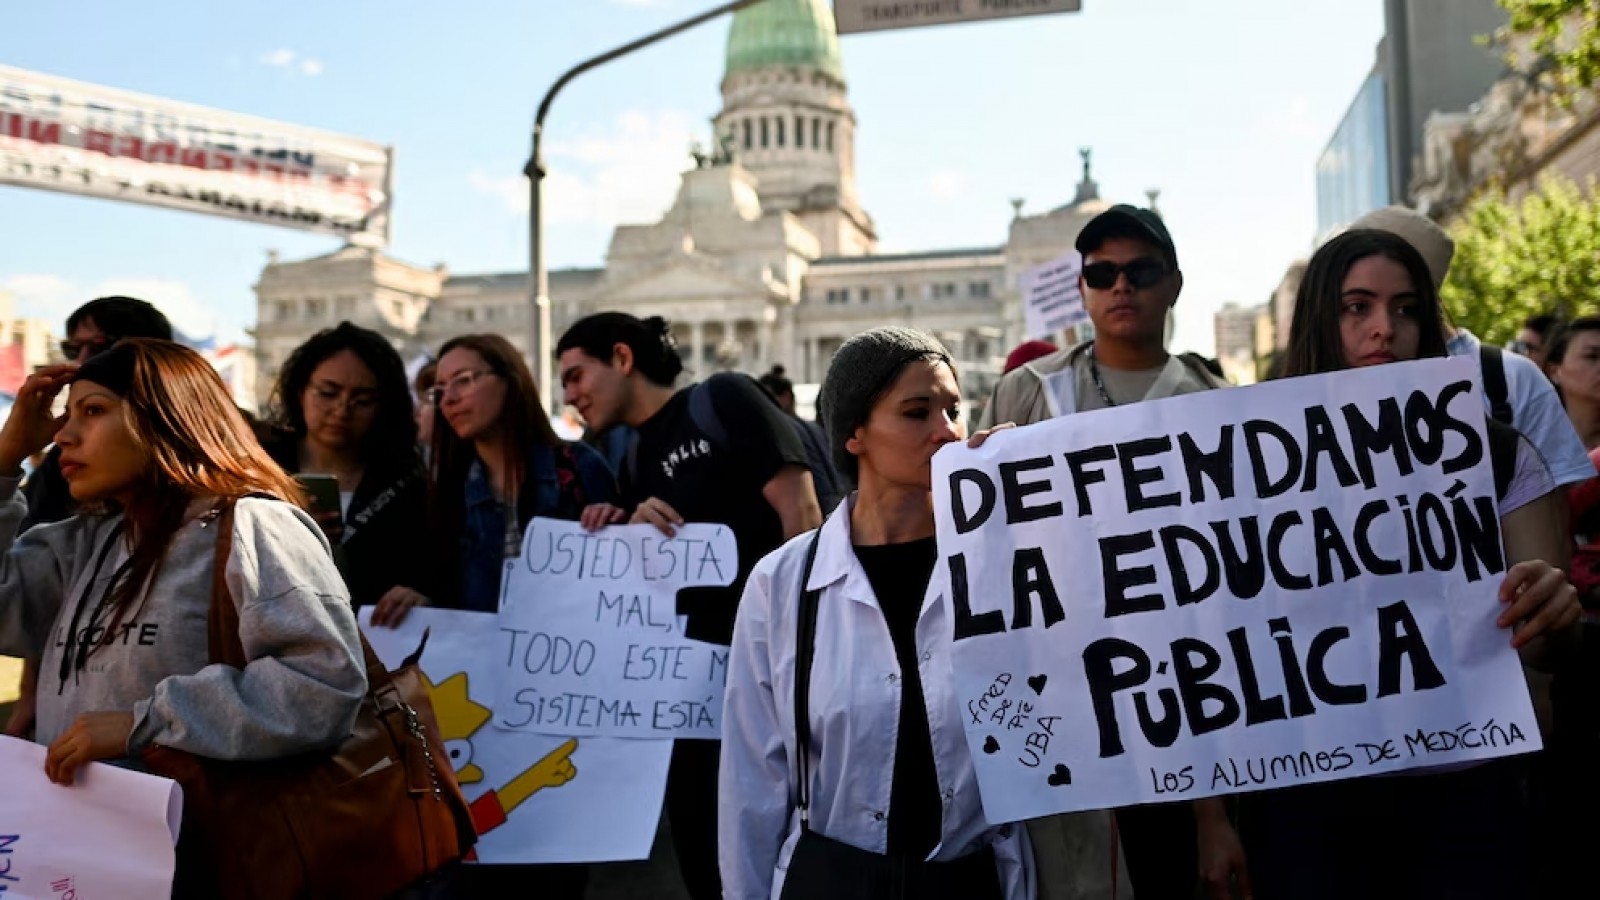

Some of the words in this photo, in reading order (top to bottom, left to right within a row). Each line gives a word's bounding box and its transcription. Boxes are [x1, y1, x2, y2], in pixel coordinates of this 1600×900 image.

[948, 380, 1484, 535] DEFENDAMOS
[948, 547, 1065, 641] LA
[1098, 479, 1505, 619] EDUCACIÓN
[500, 628, 597, 676] TODO
[622, 644, 693, 682] ESTE
[1018, 716, 1062, 768] UBA
[1151, 766, 1195, 794] LOS
[1355, 740, 1400, 766] DE
